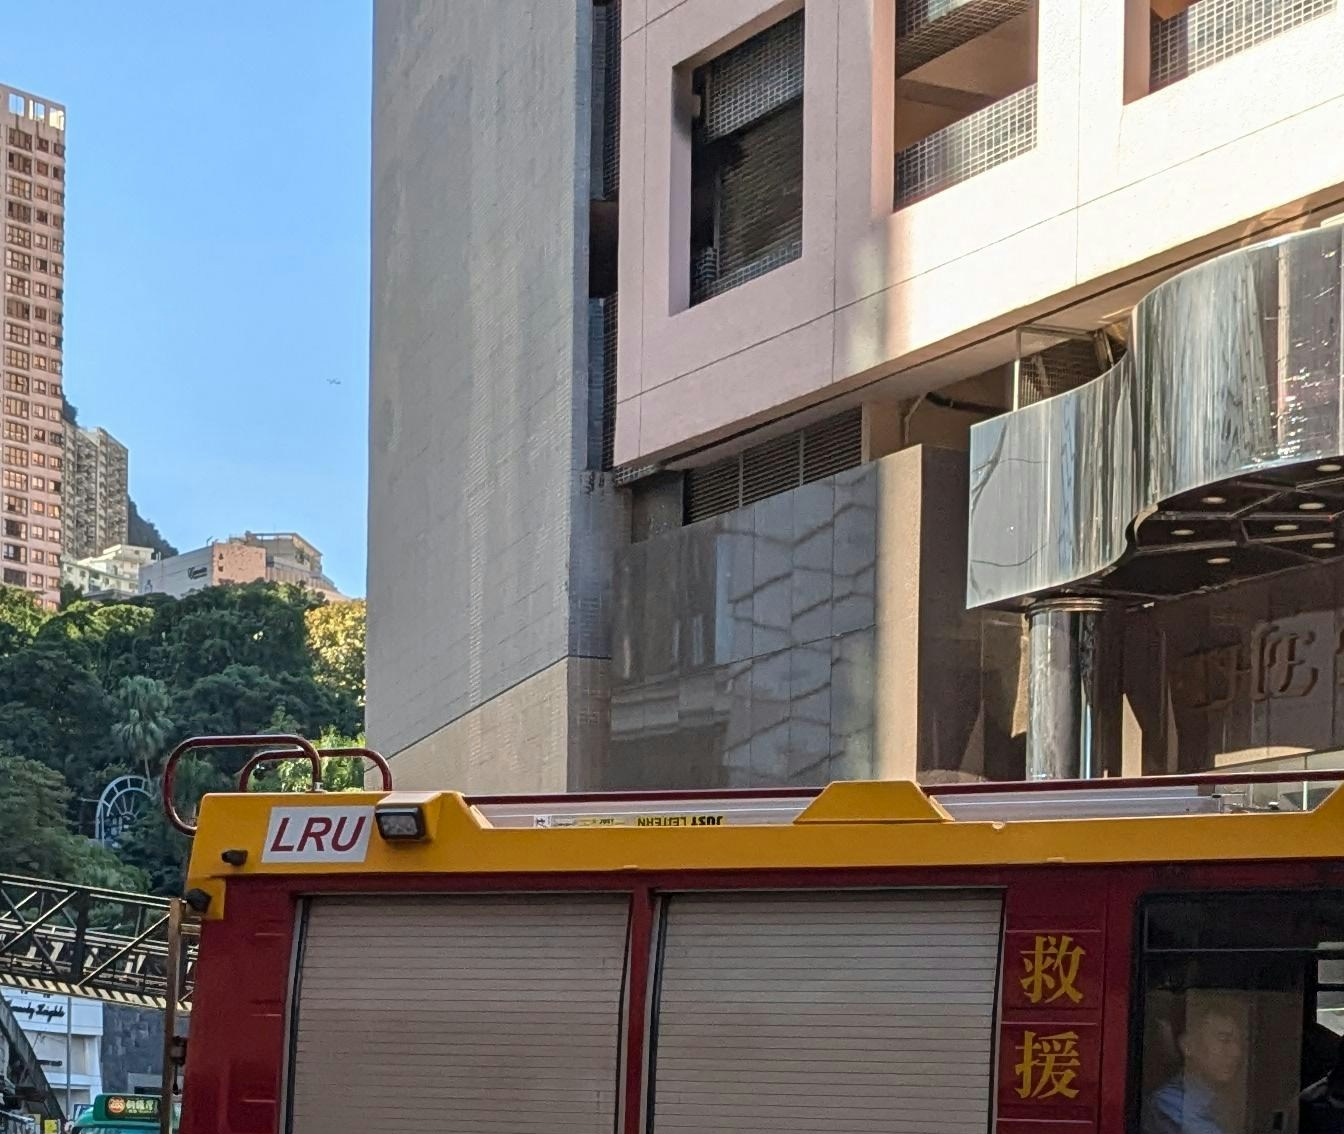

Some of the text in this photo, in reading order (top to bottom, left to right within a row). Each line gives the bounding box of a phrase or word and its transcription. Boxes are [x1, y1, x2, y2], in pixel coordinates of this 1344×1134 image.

[270, 816, 366, 852] LRU
[691, 815, 723, 826] JUST
[1014, 935, 1086, 1099] 救援
